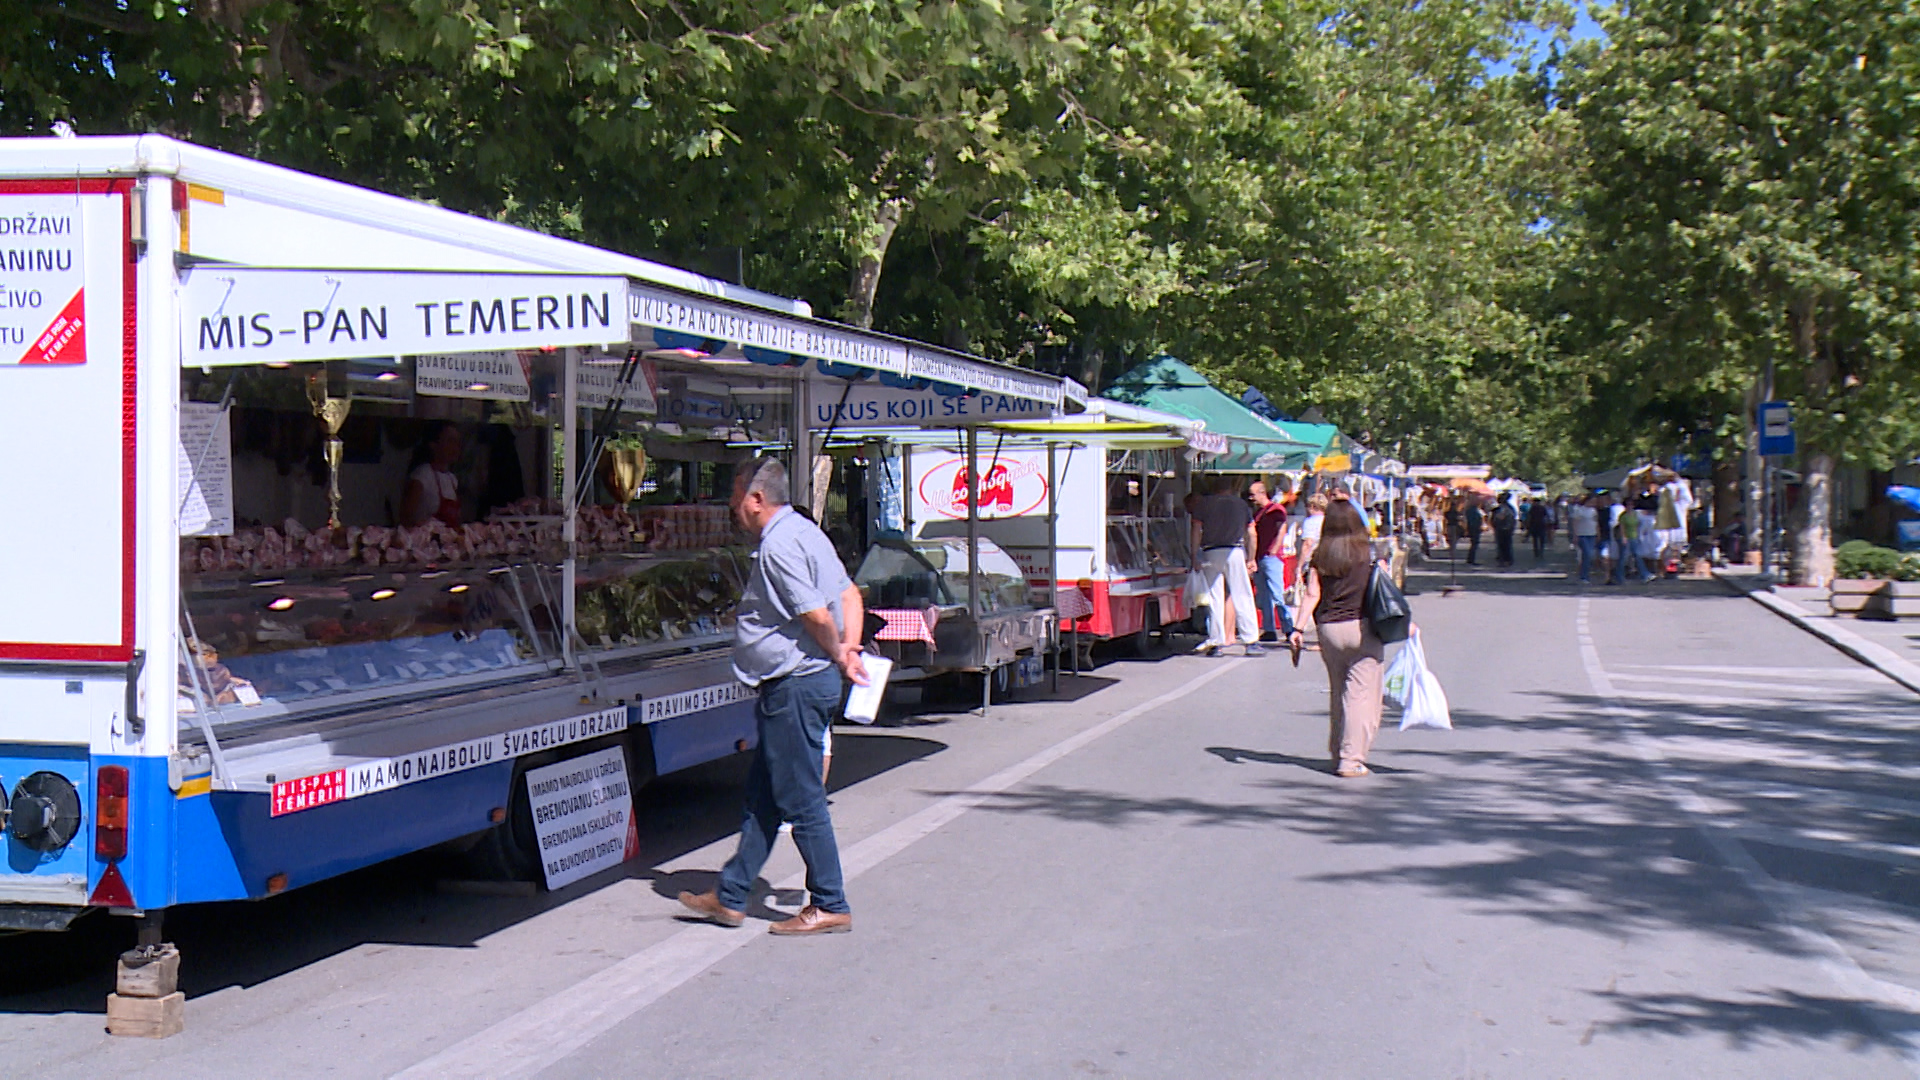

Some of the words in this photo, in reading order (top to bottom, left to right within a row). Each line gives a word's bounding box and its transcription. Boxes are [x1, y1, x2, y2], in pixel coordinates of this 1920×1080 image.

[199, 305, 388, 351] MIS-PAN
[415, 291, 610, 337] TEMERIN
[632, 295, 673, 324] UKUS
[678, 305, 753, 340] PANONSKE
[757, 320, 795, 348] NIZIJE
[818, 400, 878, 422] UKUS
[887, 398, 933, 420] KOJI
[942, 395, 968, 415] SE
[981, 394, 1055, 414] PAM
[649, 693, 699, 720] PRAVIMO
[702, 689, 715, 708] SA
[351, 759, 412, 793] IMAMO
[417, 741, 493, 778] NAJBOLJU
[503, 723, 566, 756] ŠVARGLU
[569, 722, 577, 740] U
[580, 711, 625, 736] DRŽAVI
[276, 774, 343, 797] MIS-PAN
[276, 785, 343, 812] TEMERIN
[531, 778, 559, 798] IMAMO
[536, 791, 593, 824] BRENOVANU
[541, 823, 588, 850] BRENOVANA
[547, 860, 560, 876] NA
[560, 847, 597, 872] BUKOVOM
